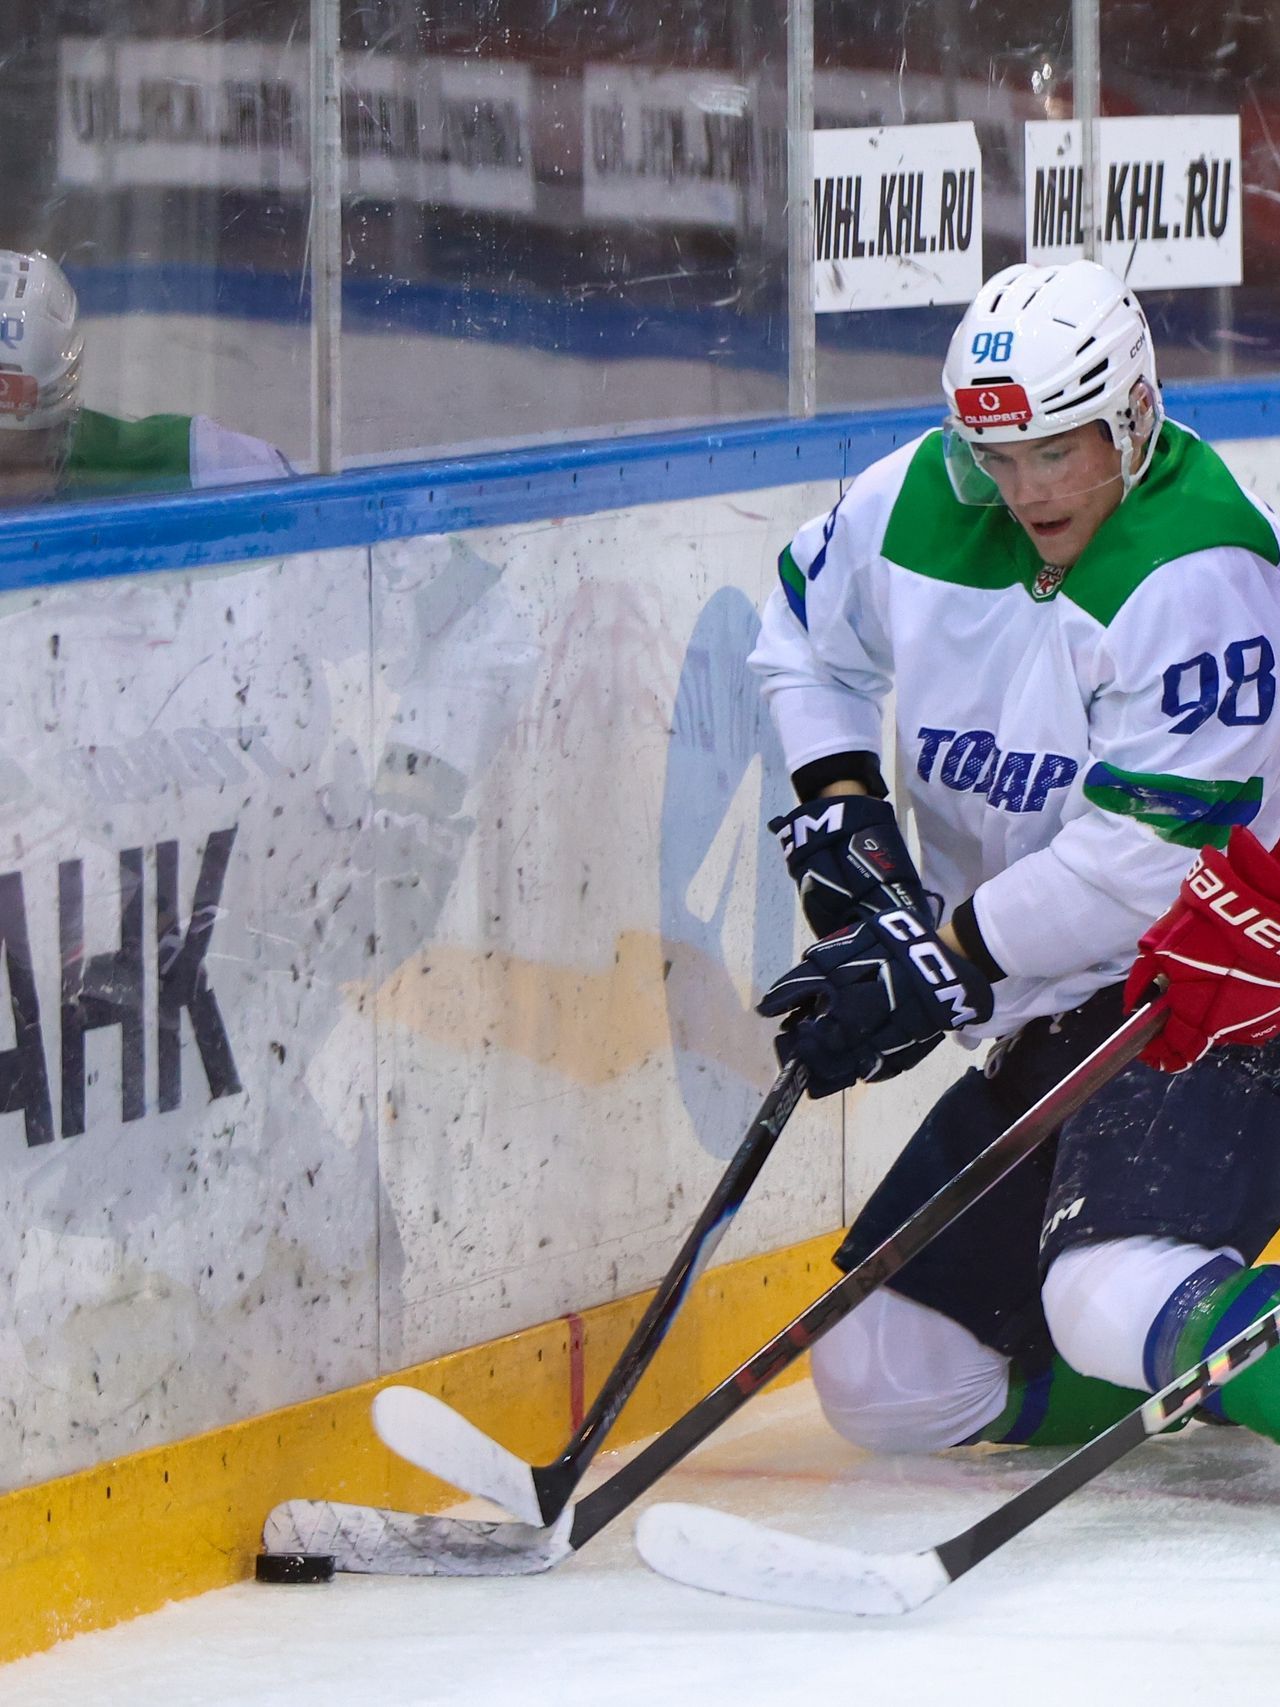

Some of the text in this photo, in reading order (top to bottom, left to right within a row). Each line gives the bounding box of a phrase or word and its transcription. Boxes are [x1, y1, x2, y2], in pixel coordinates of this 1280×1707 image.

[814, 169, 976, 262] MHL.KHL.RU
[970, 331, 1014, 364] 98
[964, 410, 1028, 424] OLIMPBET
[1160, 635, 1277, 736] 98
[878, 909, 979, 1028] CCM
